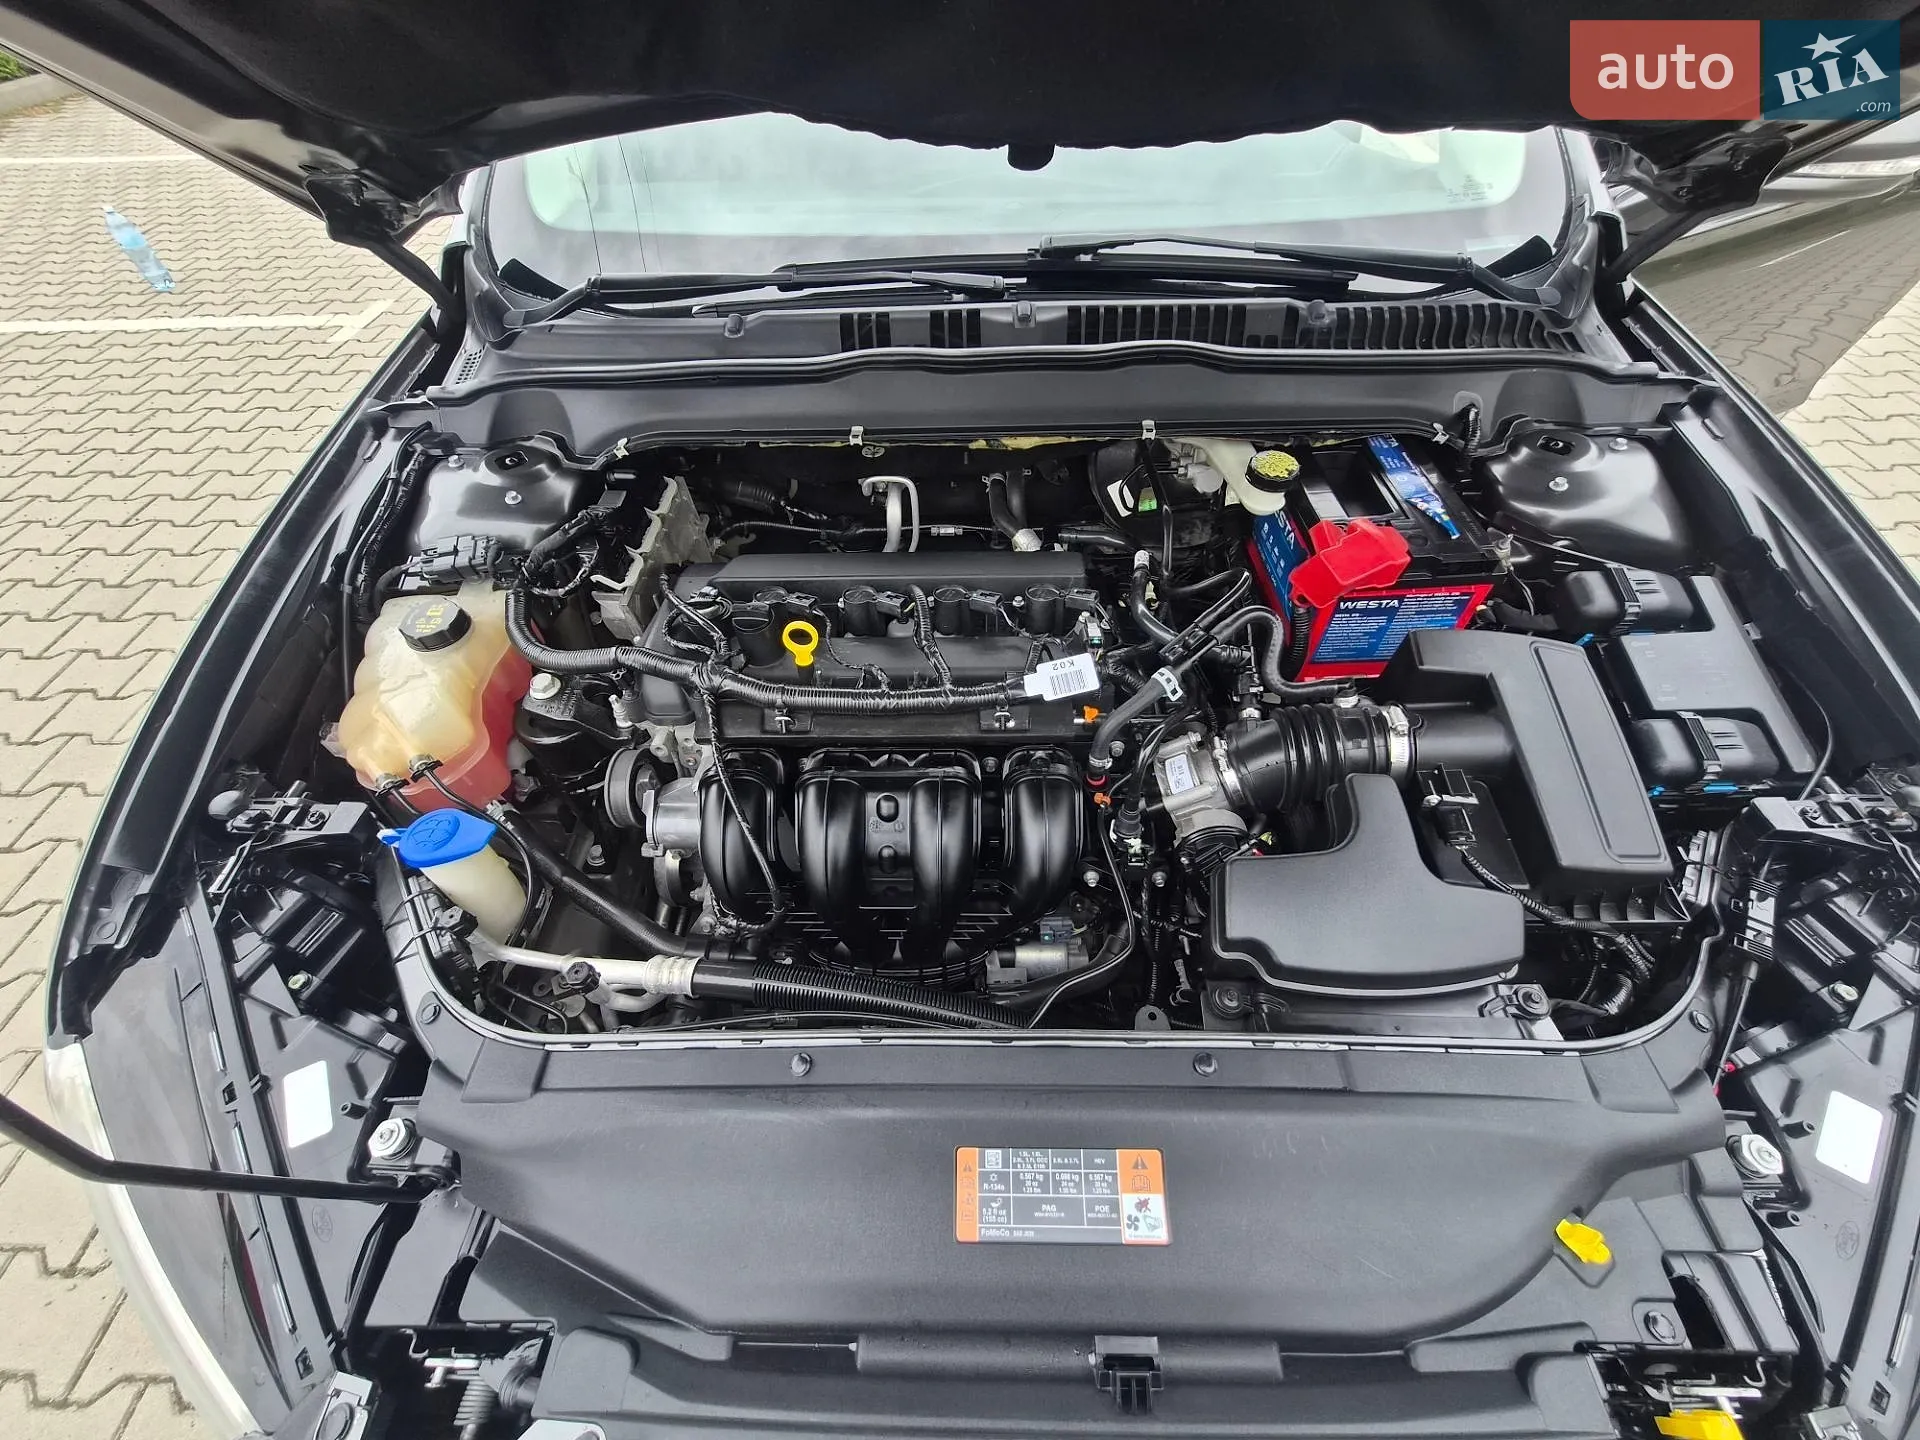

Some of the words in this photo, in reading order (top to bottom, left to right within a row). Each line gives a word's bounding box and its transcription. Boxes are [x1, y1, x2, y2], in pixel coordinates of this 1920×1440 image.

[1339, 599, 1400, 610] WESTA
[1052, 659, 1075, 671] K02
[1041, 1204, 1057, 1212] PAG
[1094, 1205, 1111, 1213] POE
[981, 1227, 1010, 1237] FoMoCo
